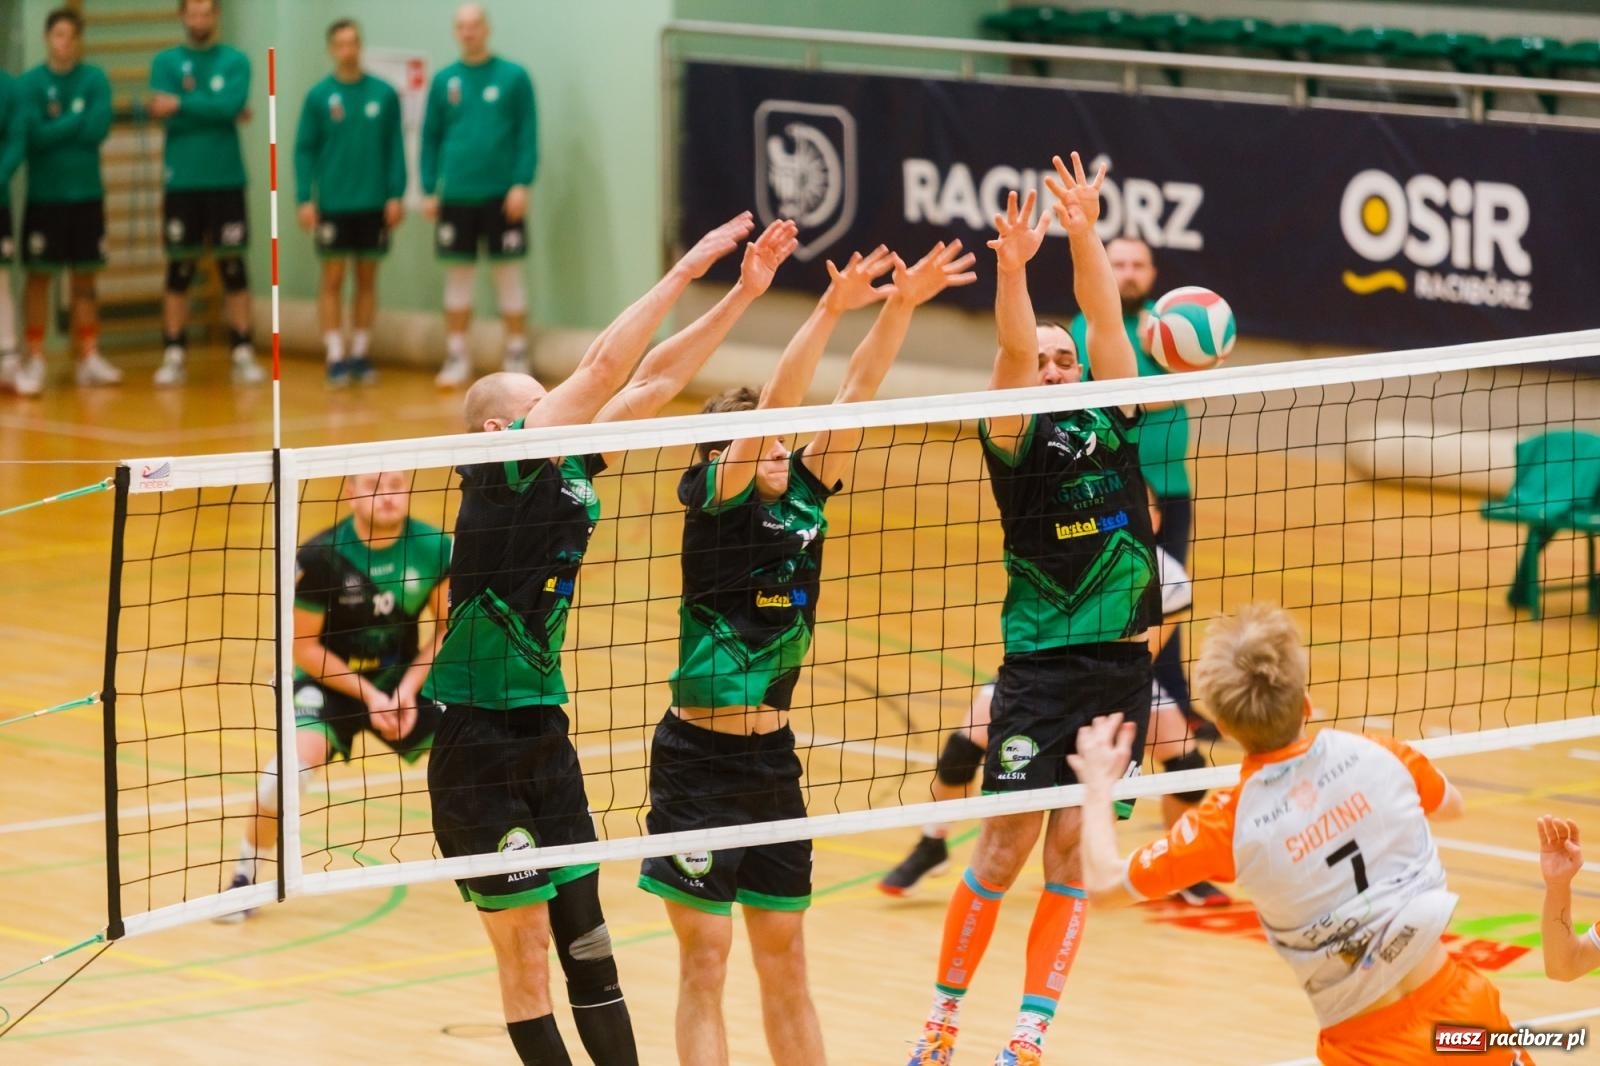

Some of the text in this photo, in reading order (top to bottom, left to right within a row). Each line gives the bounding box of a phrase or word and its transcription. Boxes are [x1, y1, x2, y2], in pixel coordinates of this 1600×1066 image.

[372, 591, 395, 616] 10
[1317, 752, 1360, 788] STEFAN
[507, 869, 538, 883] ALLSIX
[1325, 838, 1369, 894] 7
